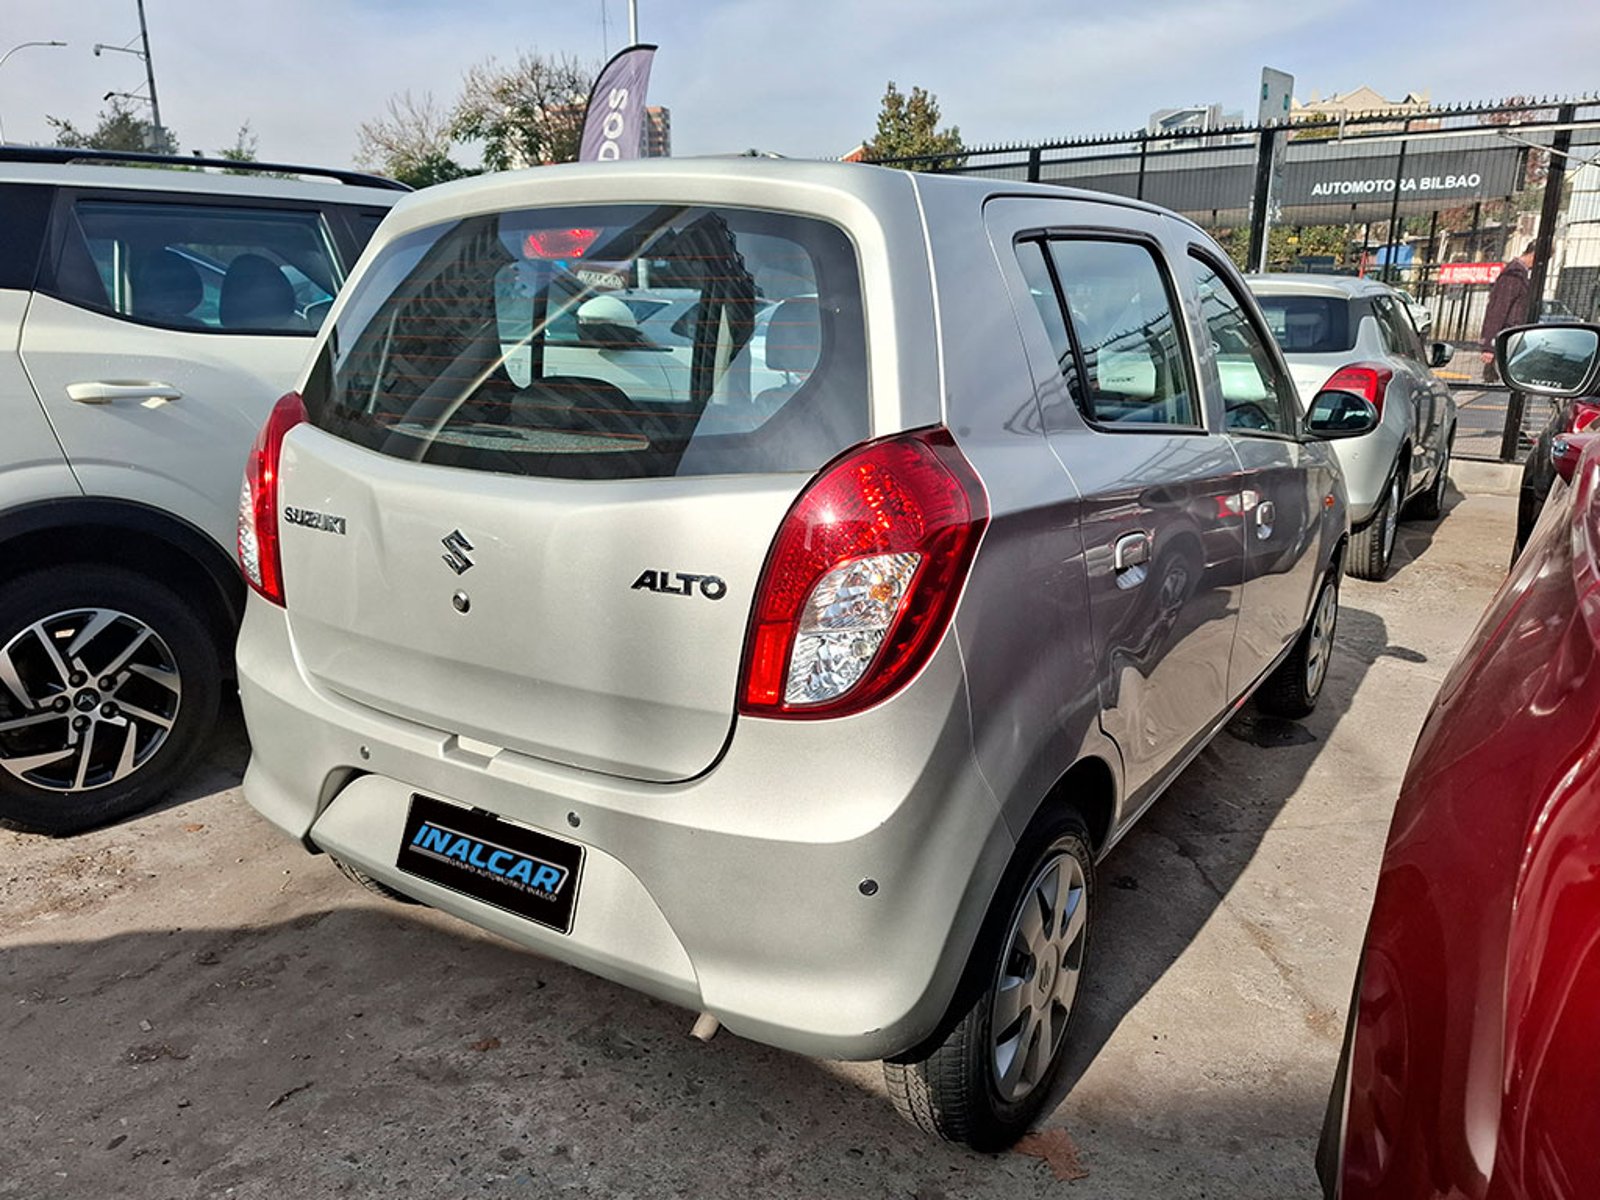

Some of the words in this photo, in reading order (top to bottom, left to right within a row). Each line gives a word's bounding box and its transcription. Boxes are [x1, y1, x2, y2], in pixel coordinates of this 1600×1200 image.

[1419, 173, 1481, 191] BILBAO
[284, 506, 347, 536] SUZUKI
[630, 569, 728, 601] ALTO
